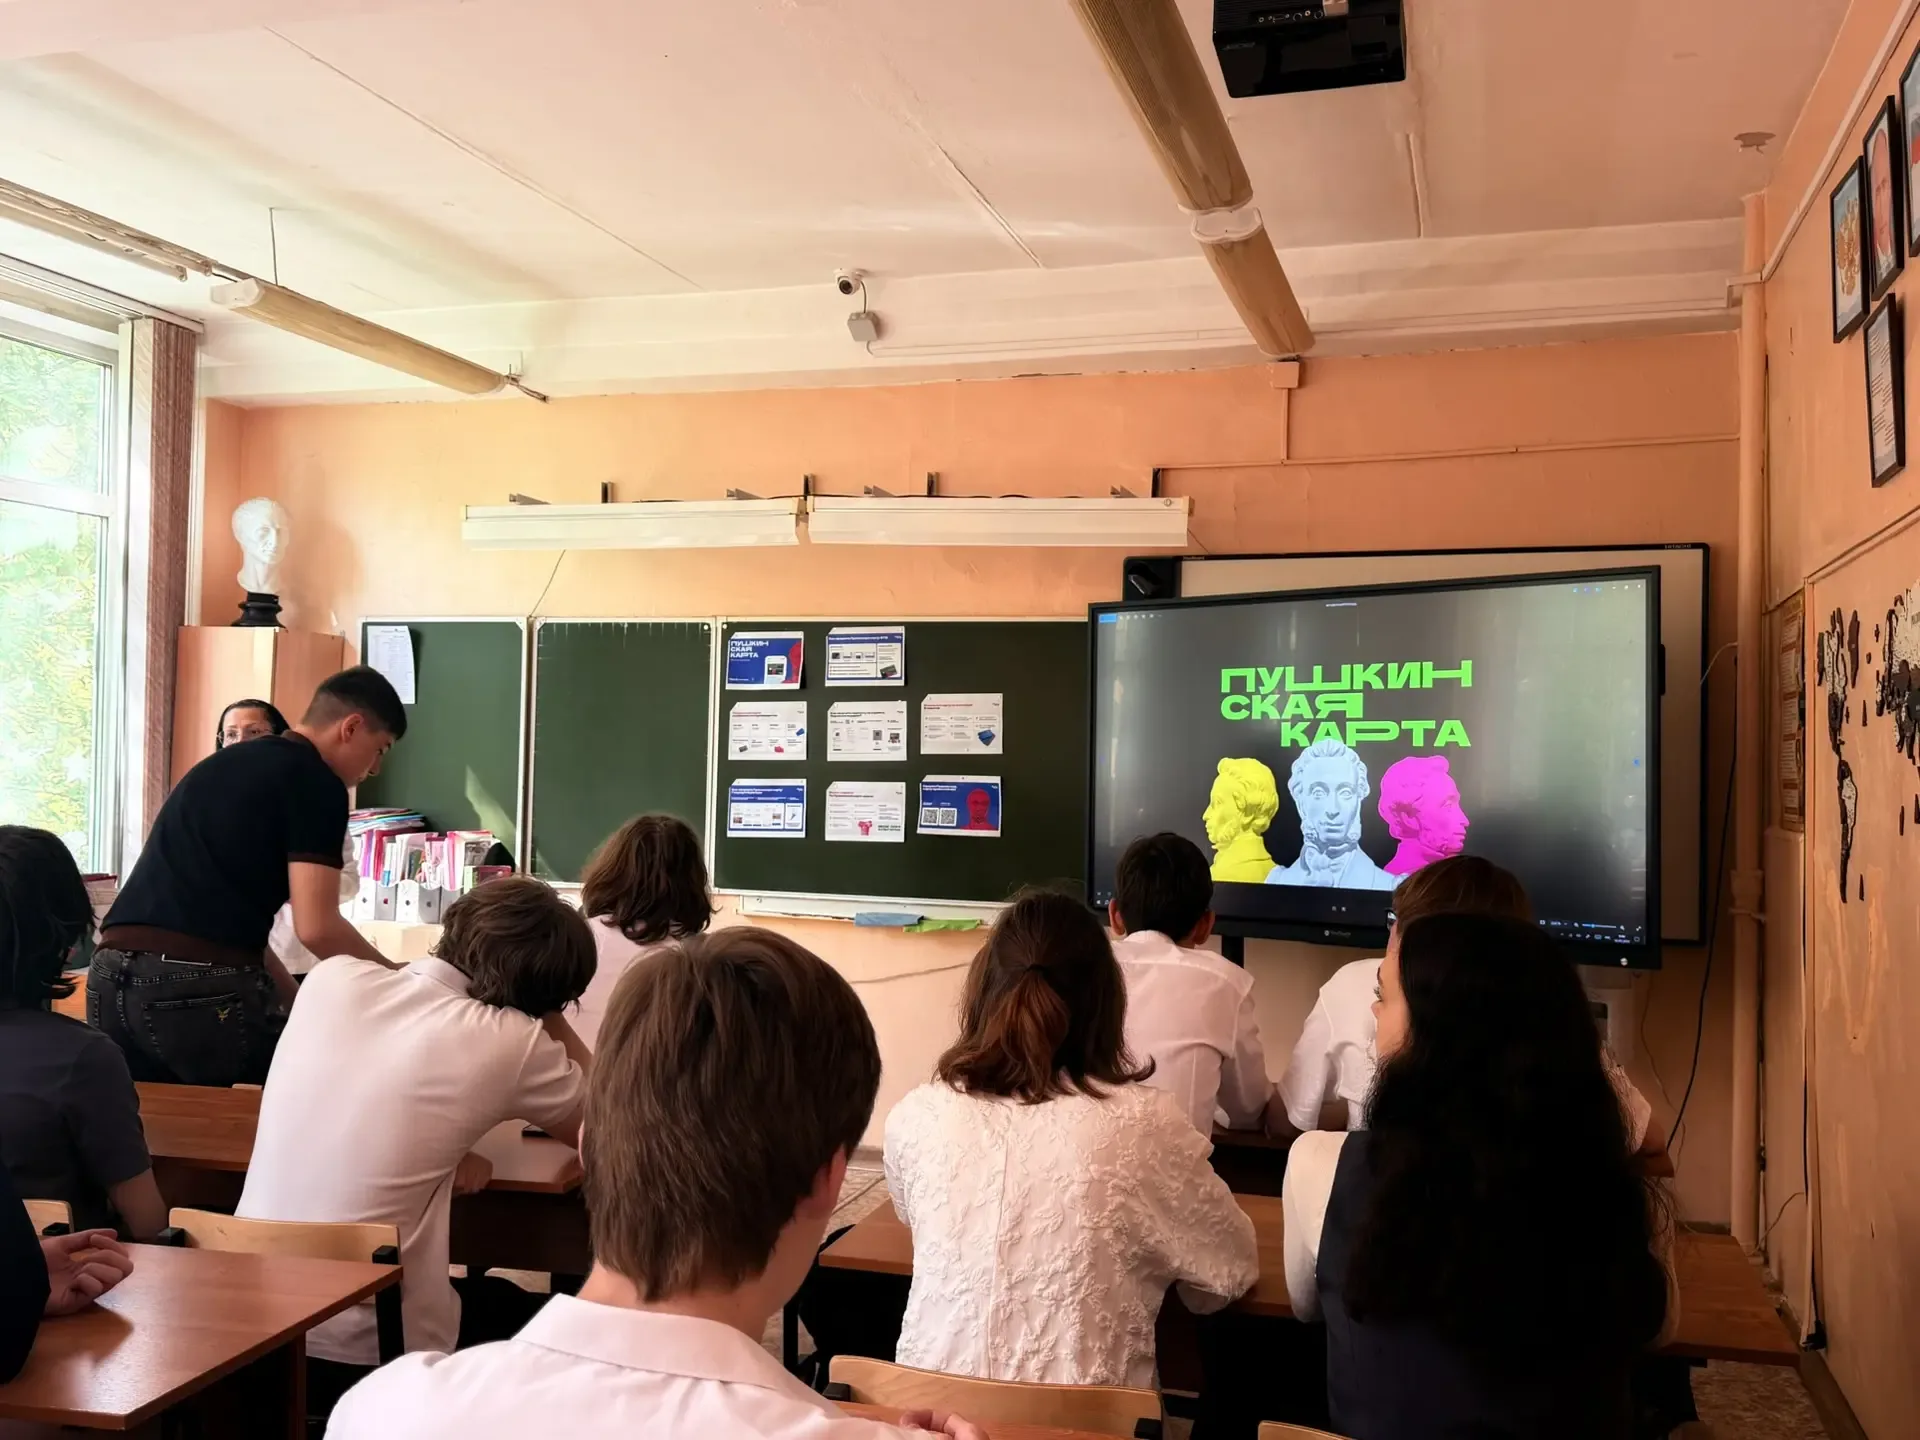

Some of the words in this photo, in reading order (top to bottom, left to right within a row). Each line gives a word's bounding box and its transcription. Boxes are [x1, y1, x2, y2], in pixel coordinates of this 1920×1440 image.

[1220, 659, 1473, 695] ПУШКИН
[1220, 692, 1364, 720] СКАЯ
[1280, 719, 1472, 748] КАРТА
